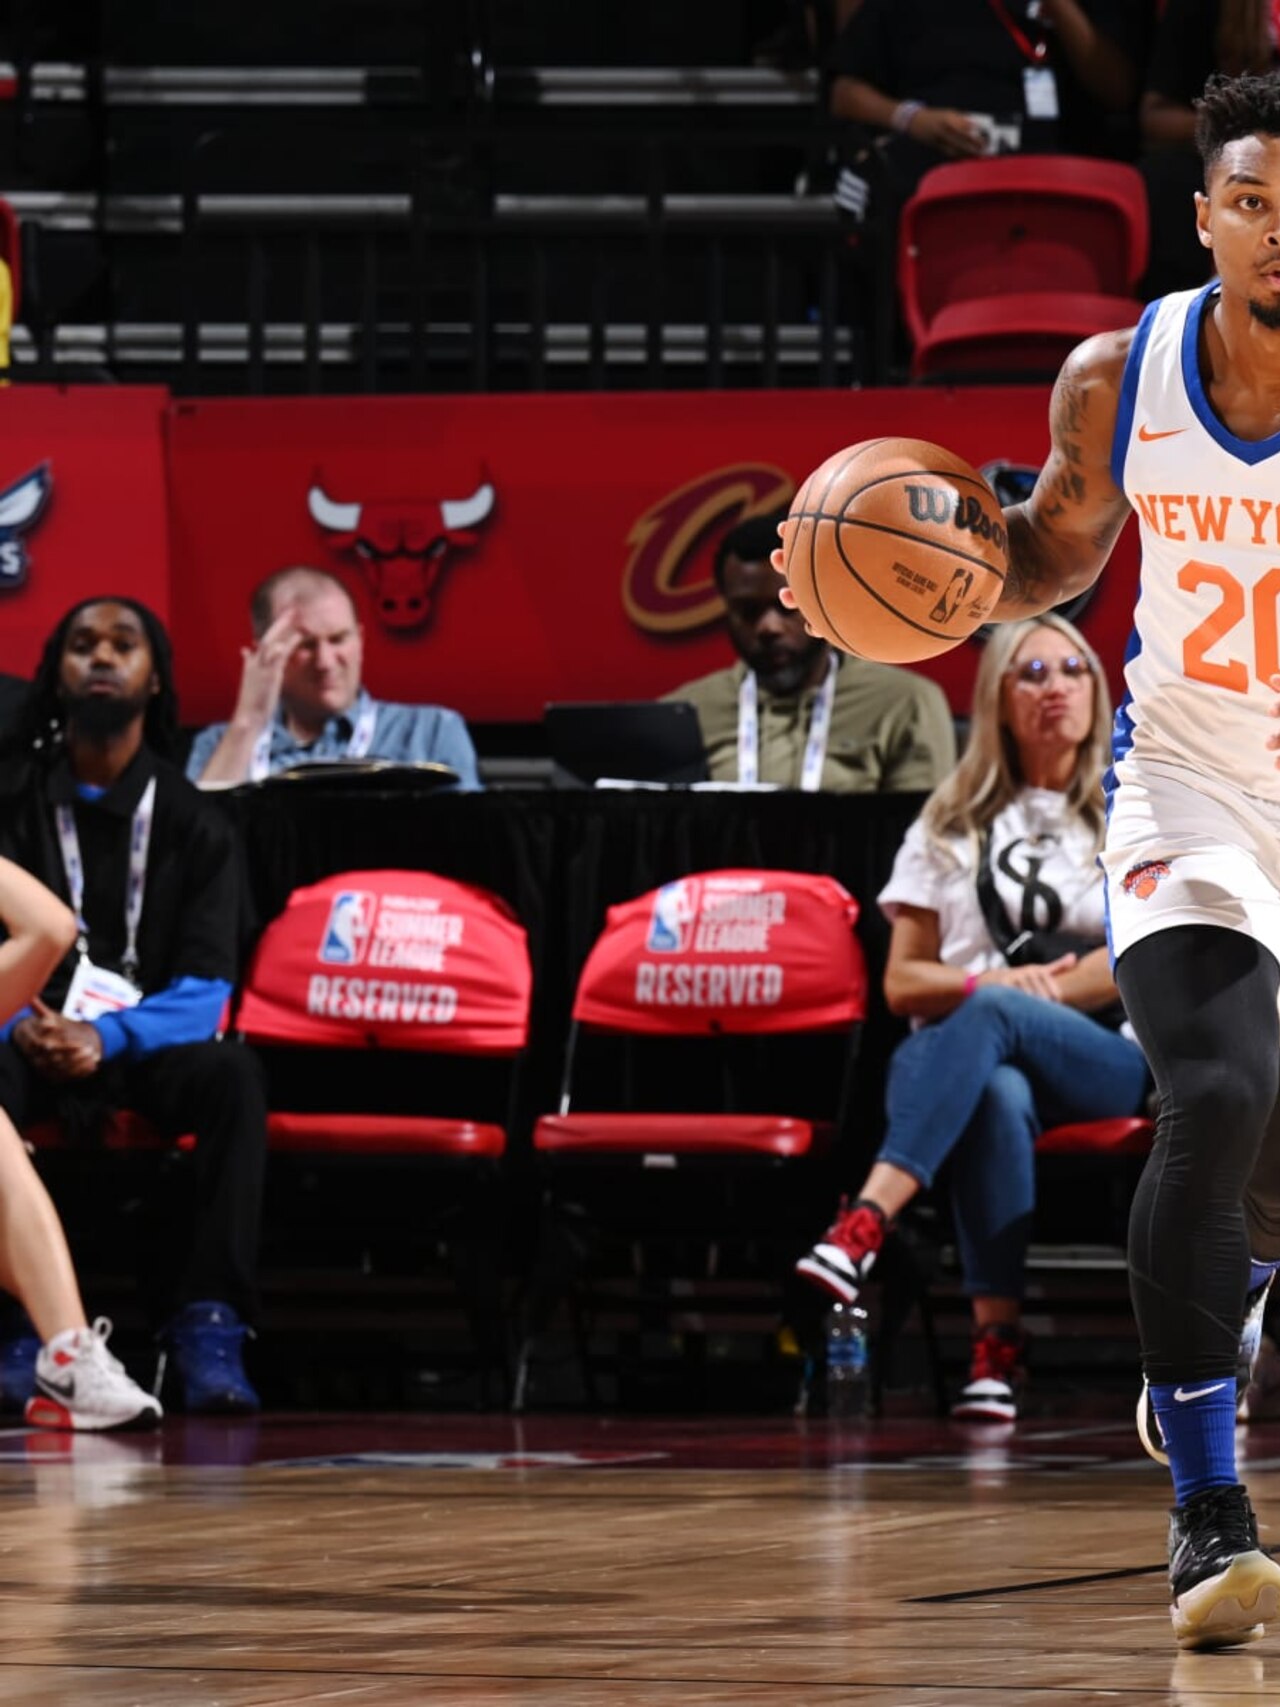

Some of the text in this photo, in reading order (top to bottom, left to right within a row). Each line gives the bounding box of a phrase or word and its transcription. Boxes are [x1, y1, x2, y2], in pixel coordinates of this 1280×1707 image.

[1134, 493, 1233, 542] NEW
[367, 934, 447, 972] LEAGUE
[695, 922, 770, 953] LEAGUE
[308, 974, 459, 1024] RESERVED
[635, 962, 784, 1006] RESERVED
